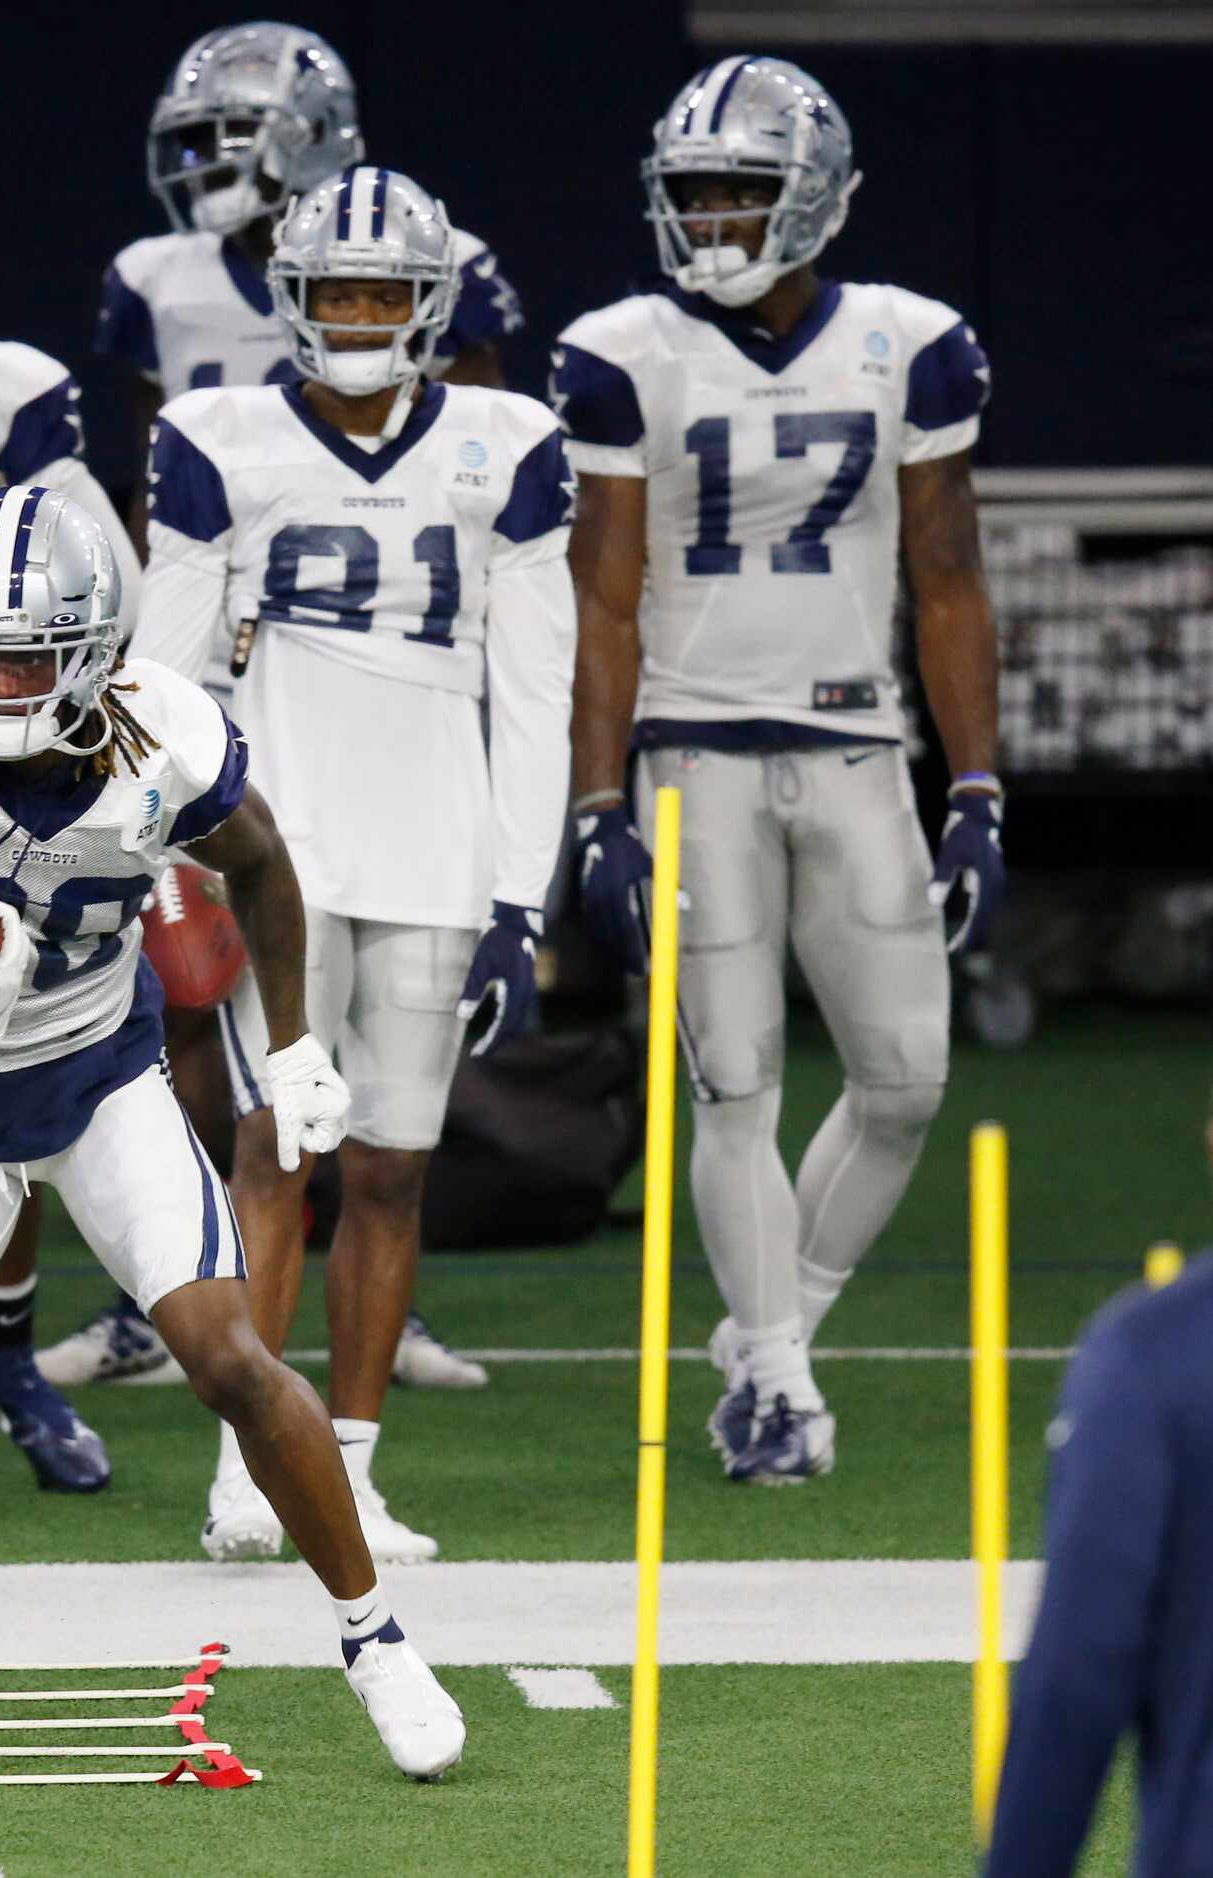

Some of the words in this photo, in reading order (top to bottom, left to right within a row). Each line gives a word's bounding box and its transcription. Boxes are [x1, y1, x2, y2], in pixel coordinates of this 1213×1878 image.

[454, 472, 489, 488] AT&T
[684, 411, 877, 575] 17
[11, 850, 79, 865] COWBOYS
